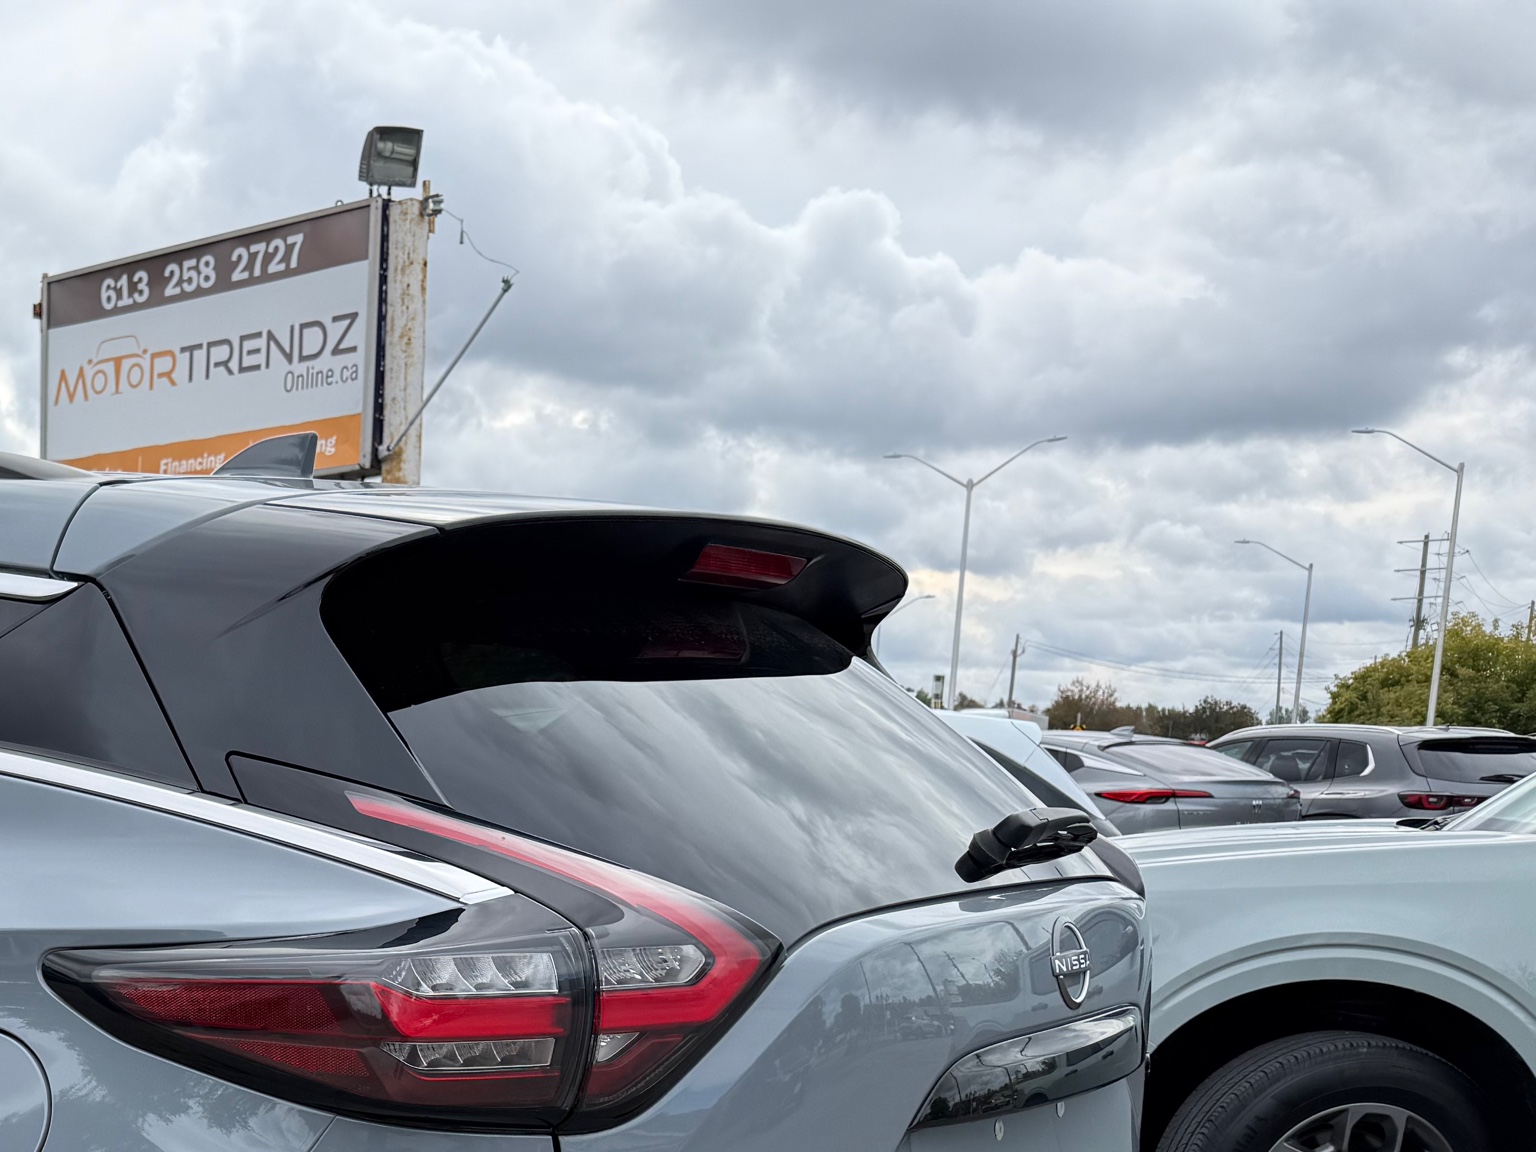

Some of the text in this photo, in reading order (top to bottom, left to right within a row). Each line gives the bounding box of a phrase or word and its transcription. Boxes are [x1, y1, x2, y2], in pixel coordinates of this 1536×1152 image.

[100, 233, 304, 311] 613 258 2727
[283, 363, 359, 394] Online.ca
[159, 452, 226, 475] Financing
[1054, 953, 1090, 973] NISS
